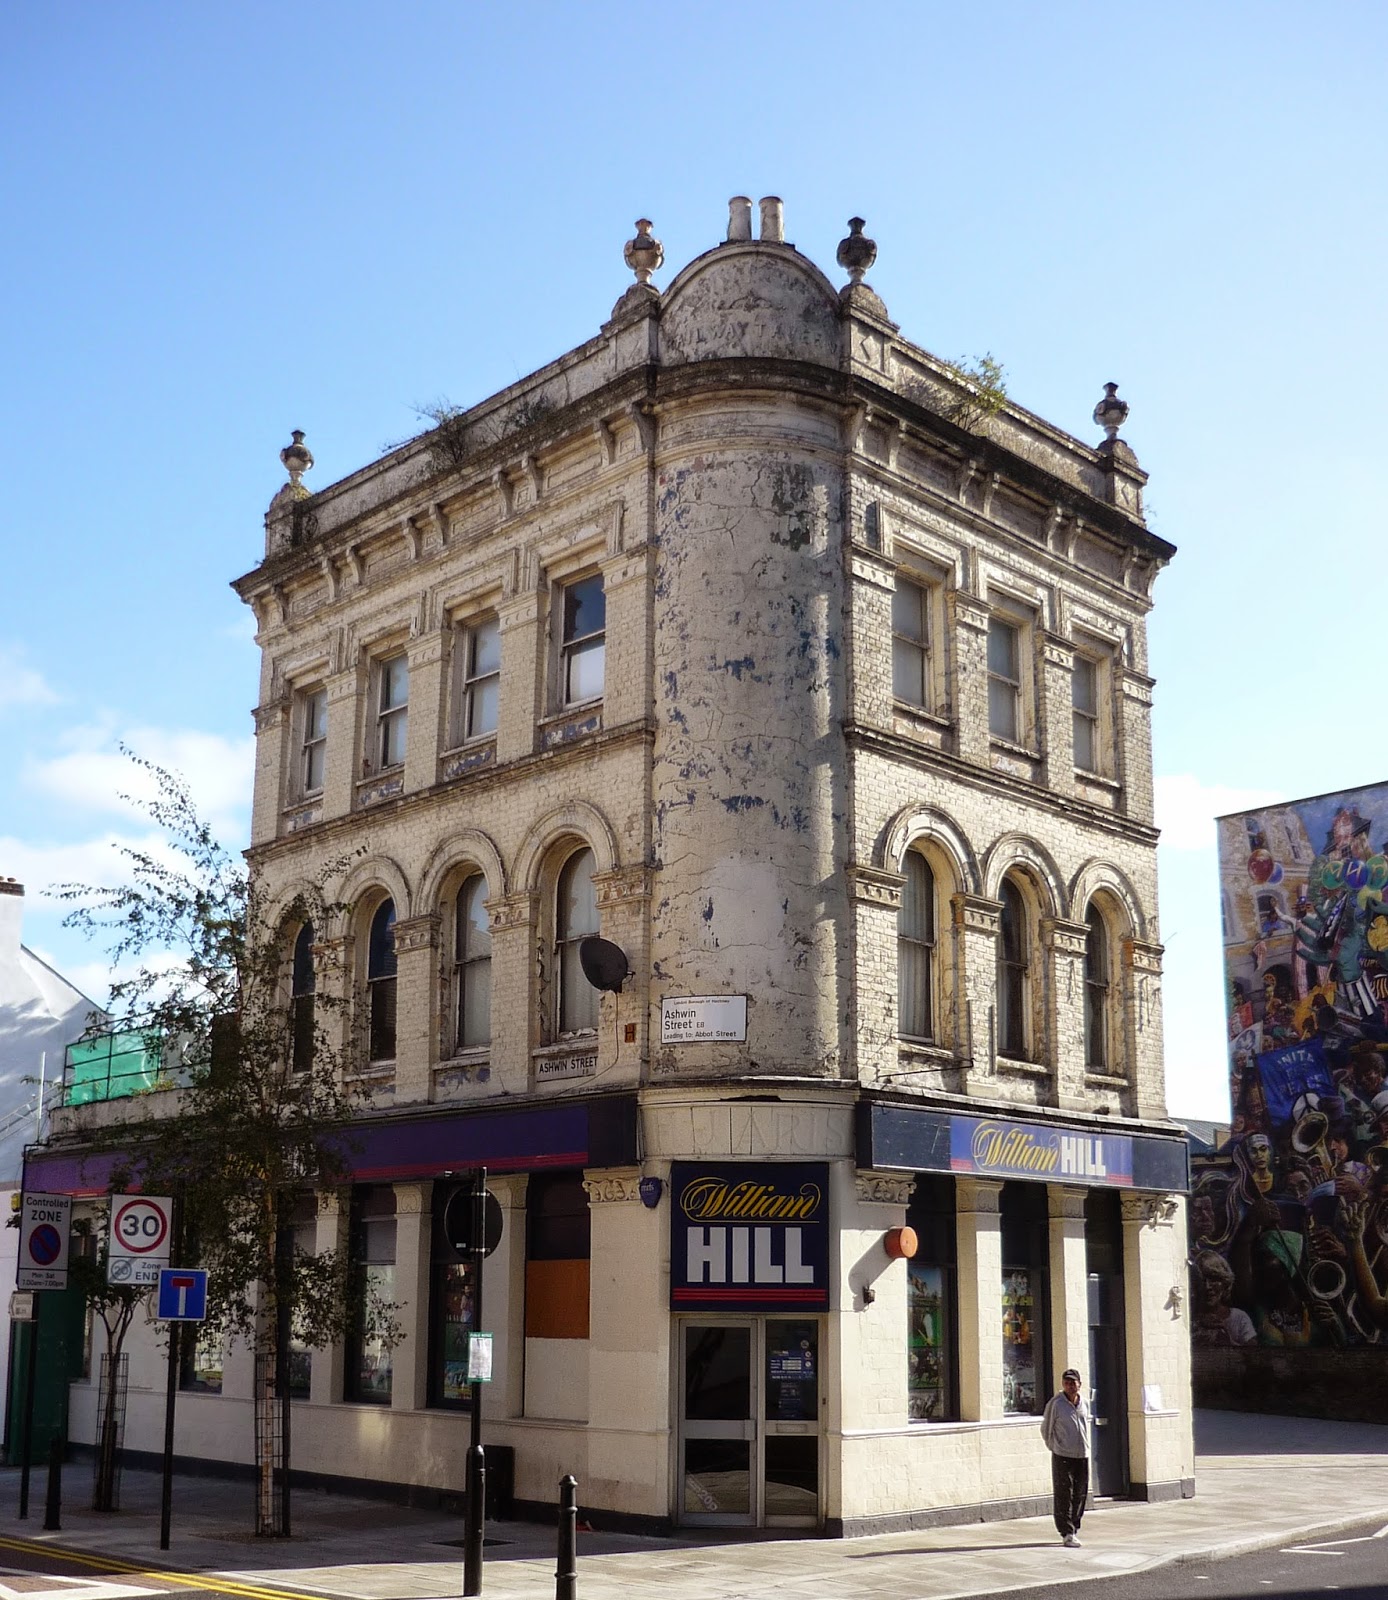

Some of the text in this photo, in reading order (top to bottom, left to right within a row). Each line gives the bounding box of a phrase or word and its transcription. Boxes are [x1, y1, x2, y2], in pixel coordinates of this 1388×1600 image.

[664, 1008, 697, 1020] Ashwin
[664, 1019, 705, 1031] Street E8
[663, 1031, 684, 1040] Leading
[695, 1030, 713, 1038] Abbot
[715, 1030, 737, 1038] Street
[538, 1060, 568, 1074] ASHWIN
[570, 1055, 599, 1070] STREET
[972, 1120, 1107, 1177] William HILL
[26, 1196, 69, 1209] Controlled
[680, 1176, 821, 1224] William
[31, 1210, 62, 1222] ZONE
[122, 1213, 160, 1238] 30
[686, 1226, 815, 1284] HILL
[114, 1265, 129, 1276] 20
[141, 1262, 162, 1270] Zone
[135, 1271, 159, 1281] END
